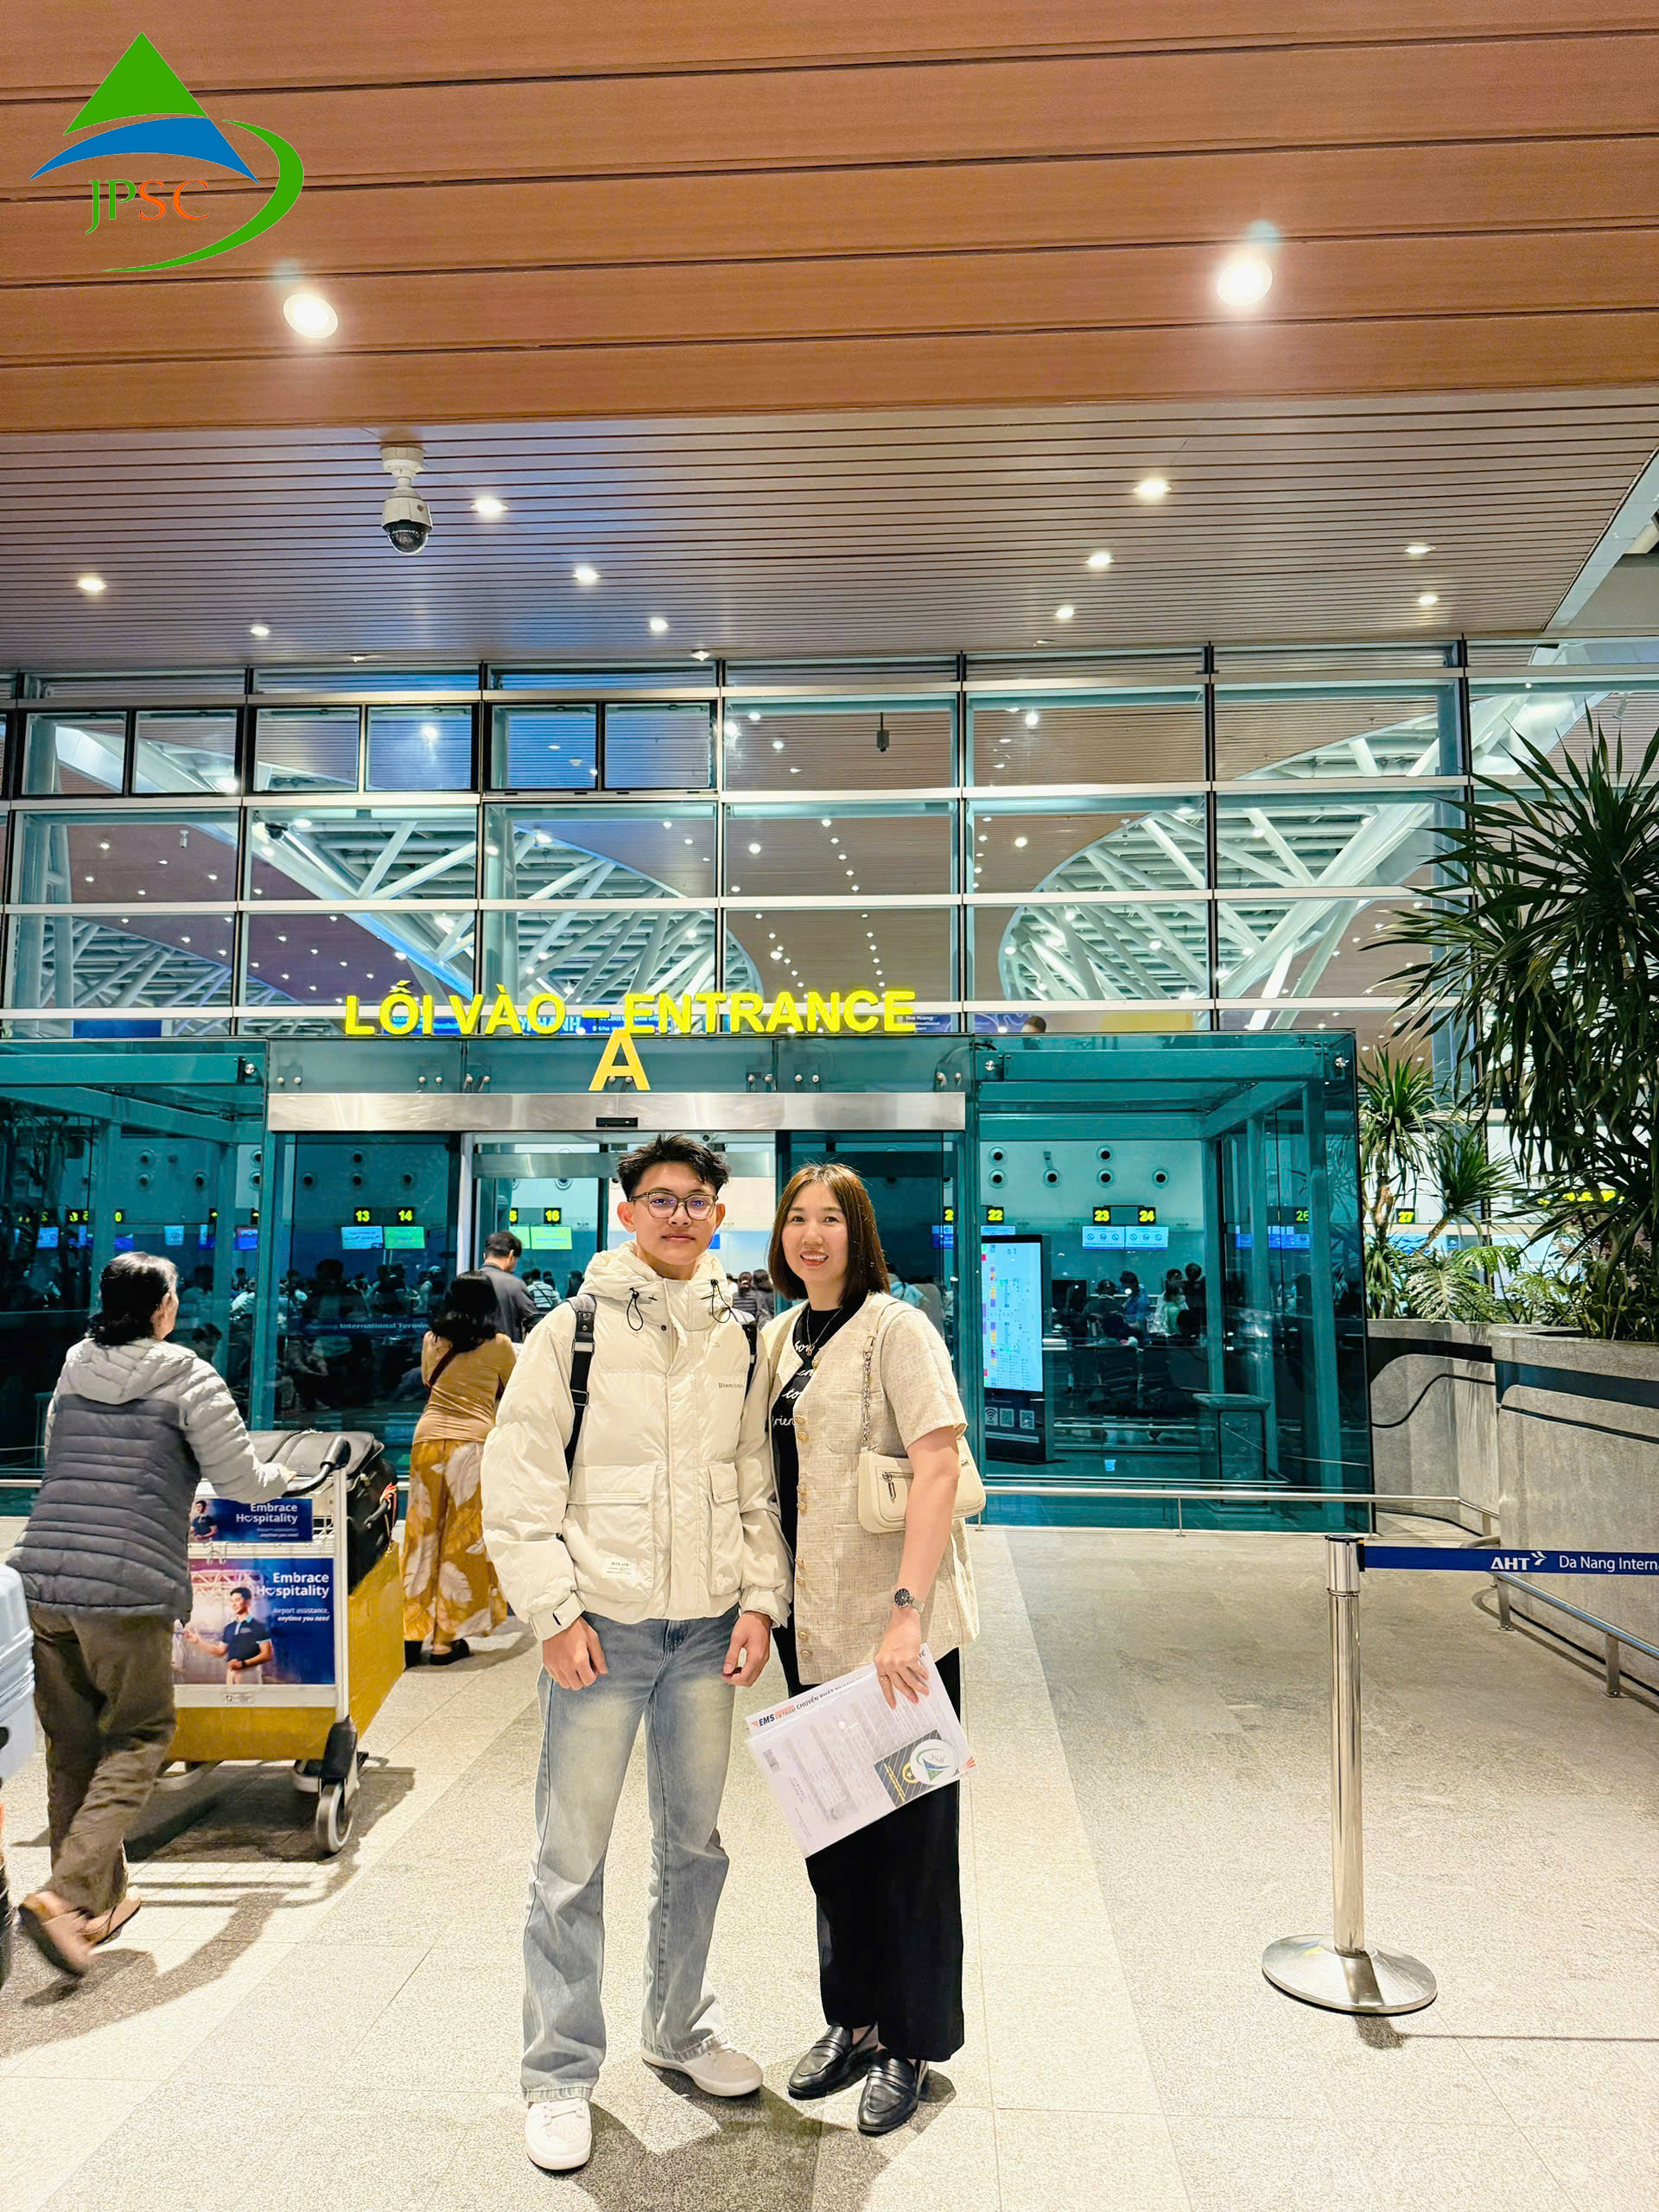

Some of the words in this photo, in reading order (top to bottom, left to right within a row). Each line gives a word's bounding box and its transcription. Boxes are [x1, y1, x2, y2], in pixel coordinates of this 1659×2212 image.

[345, 980, 433, 1035] LỐI
[448, 983, 567, 1036] VÀO
[624, 989, 918, 1034] ENTRANCE
[588, 1028, 652, 1092] A
[355, 1210, 370, 1222] 13
[398, 1210, 413, 1222] 14
[509, 1210, 518, 1222] 5
[944, 1210, 954, 1221] 2
[988, 1210, 1003, 1221] 22
[1095, 1210, 1110, 1222] 23
[1139, 1210, 1155, 1222] 24
[1398, 1211, 1414, 1223] 27
[772, 1414, 795, 1427] rien
[251, 1503, 298, 1512] Embrace
[1559, 1555, 1577, 1568] Da
[1580, 1556, 1616, 1573] Nang
[272, 1572, 329, 1583] Embrace
[758, 1713, 775, 1727] EMS
